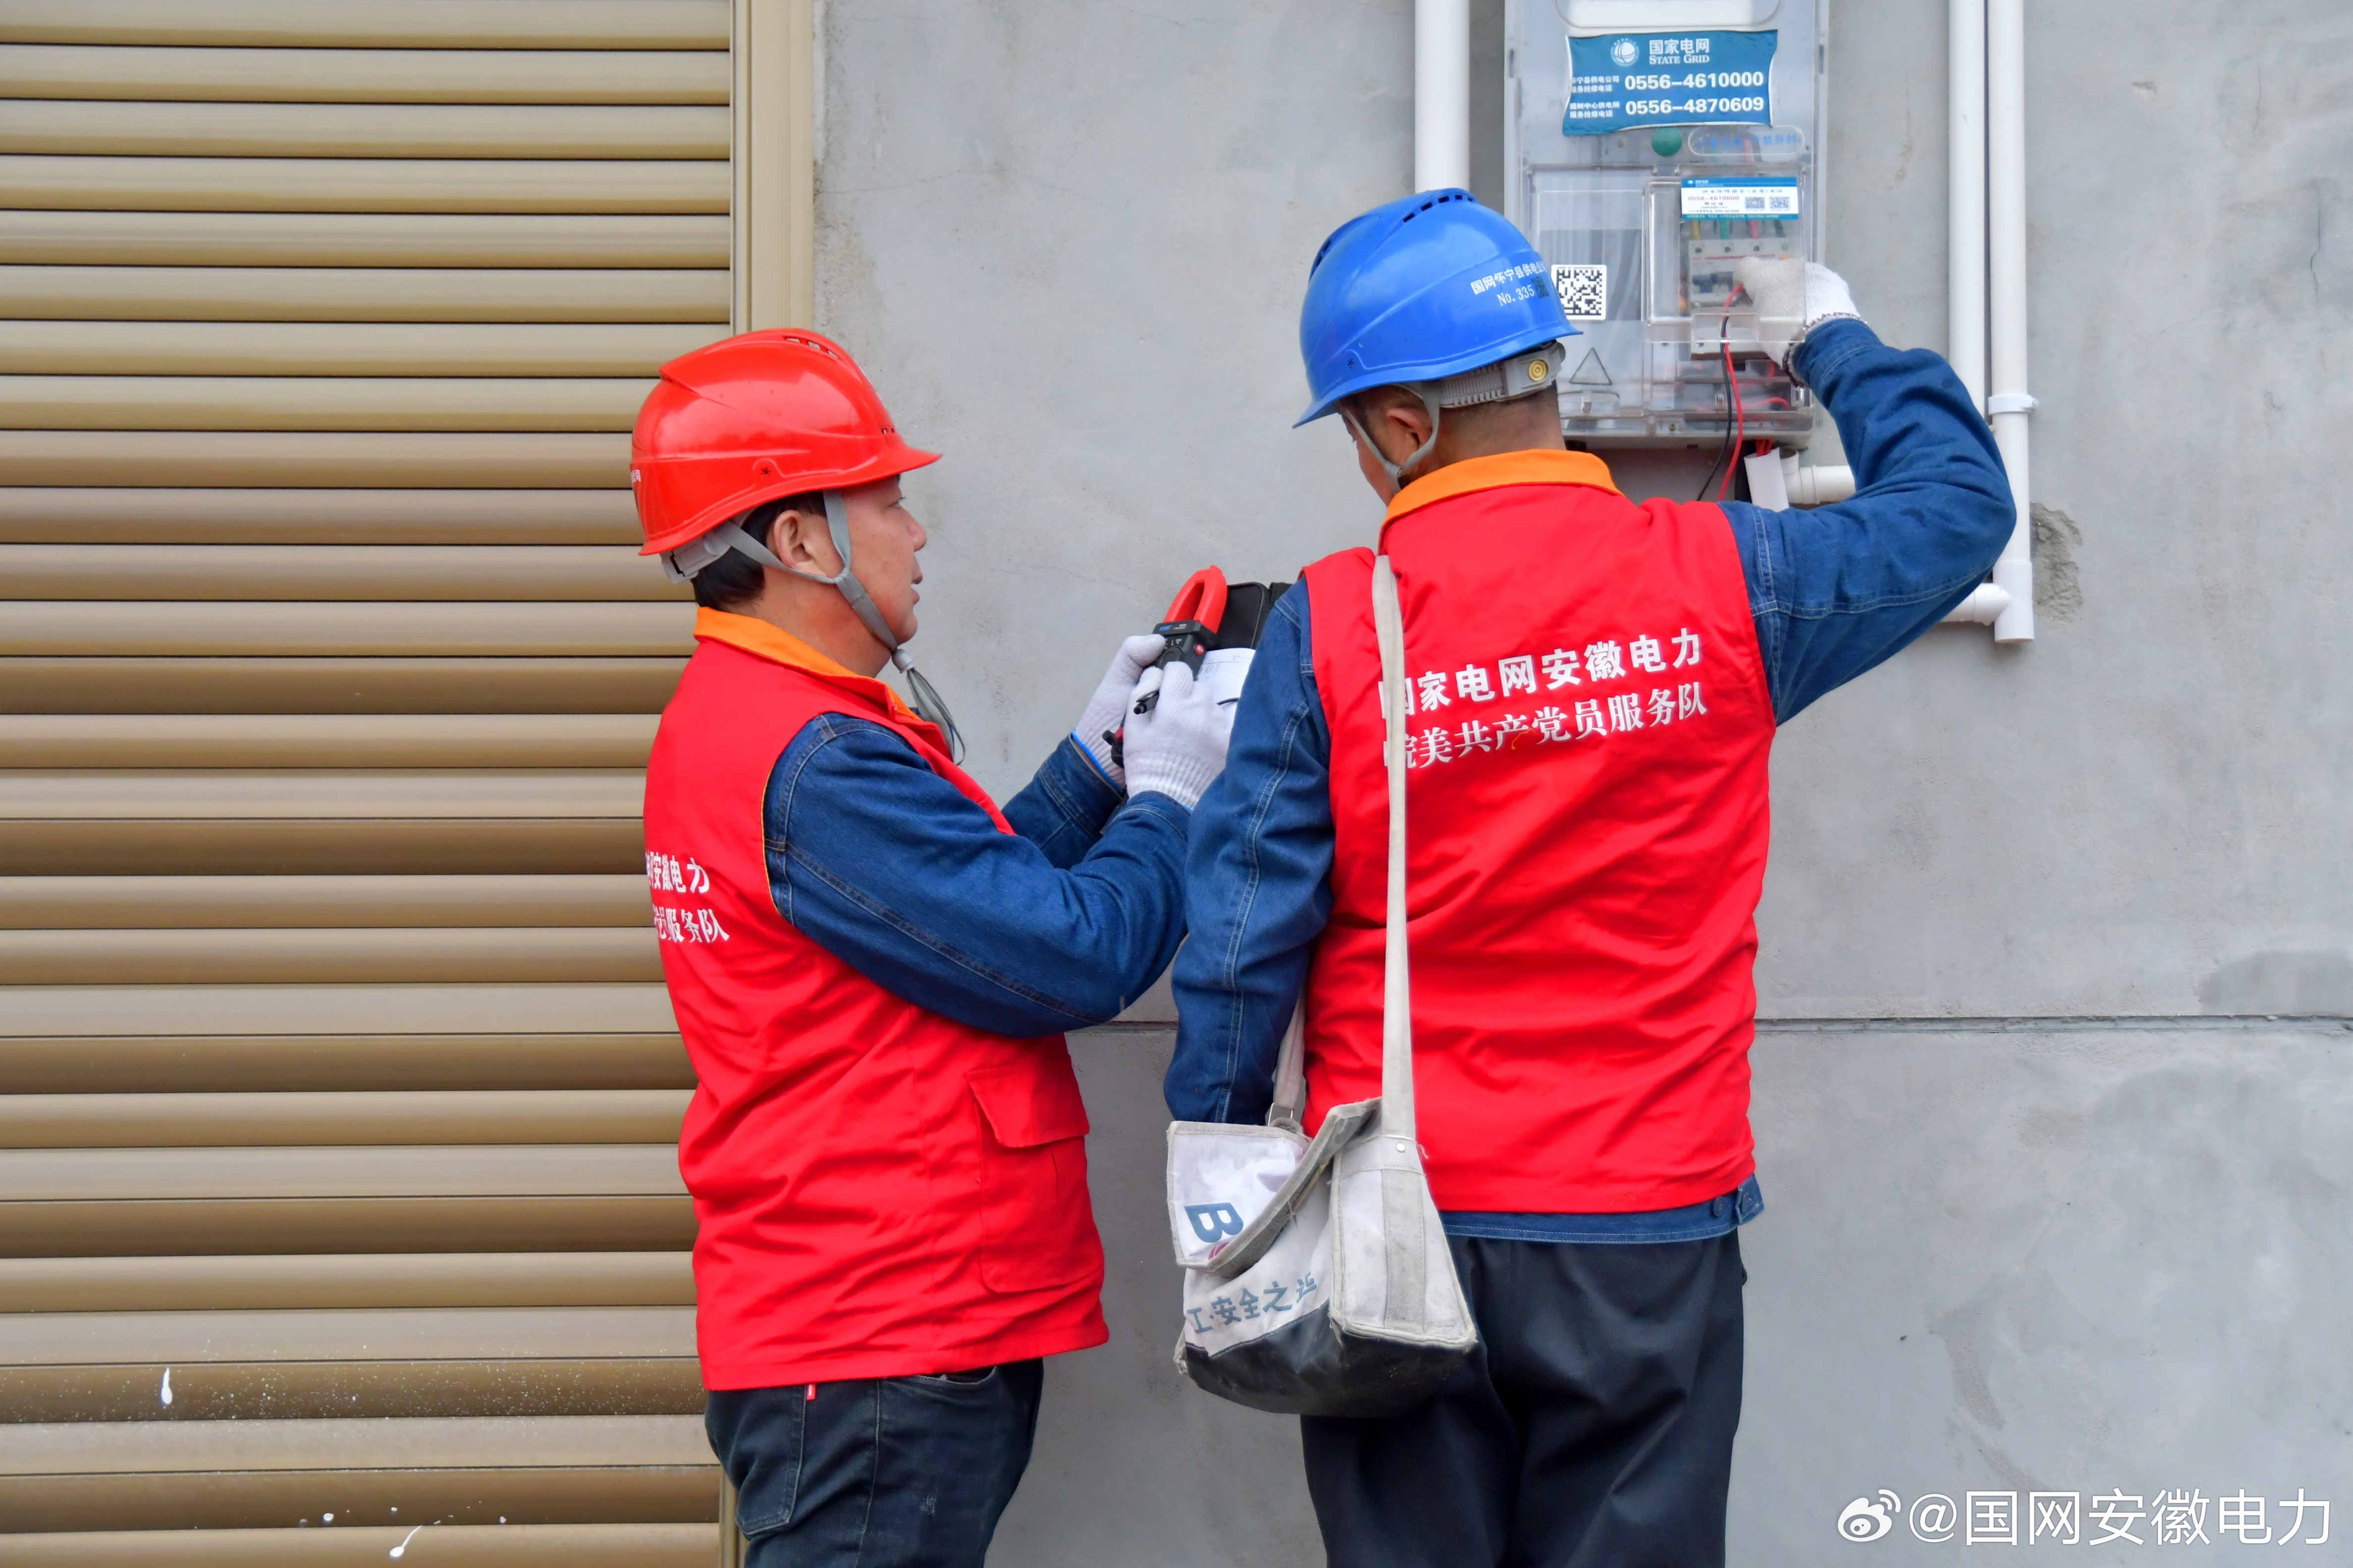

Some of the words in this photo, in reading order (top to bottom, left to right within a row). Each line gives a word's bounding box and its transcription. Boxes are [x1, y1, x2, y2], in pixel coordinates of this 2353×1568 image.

[1649, 38, 1710, 55] 国家电网
[1649, 54, 1680, 65] STATE
[1684, 54, 1710, 64] GRID
[1624, 71, 1764, 91] 0556-4610000
[1625, 97, 1765, 115] 0556-4870609
